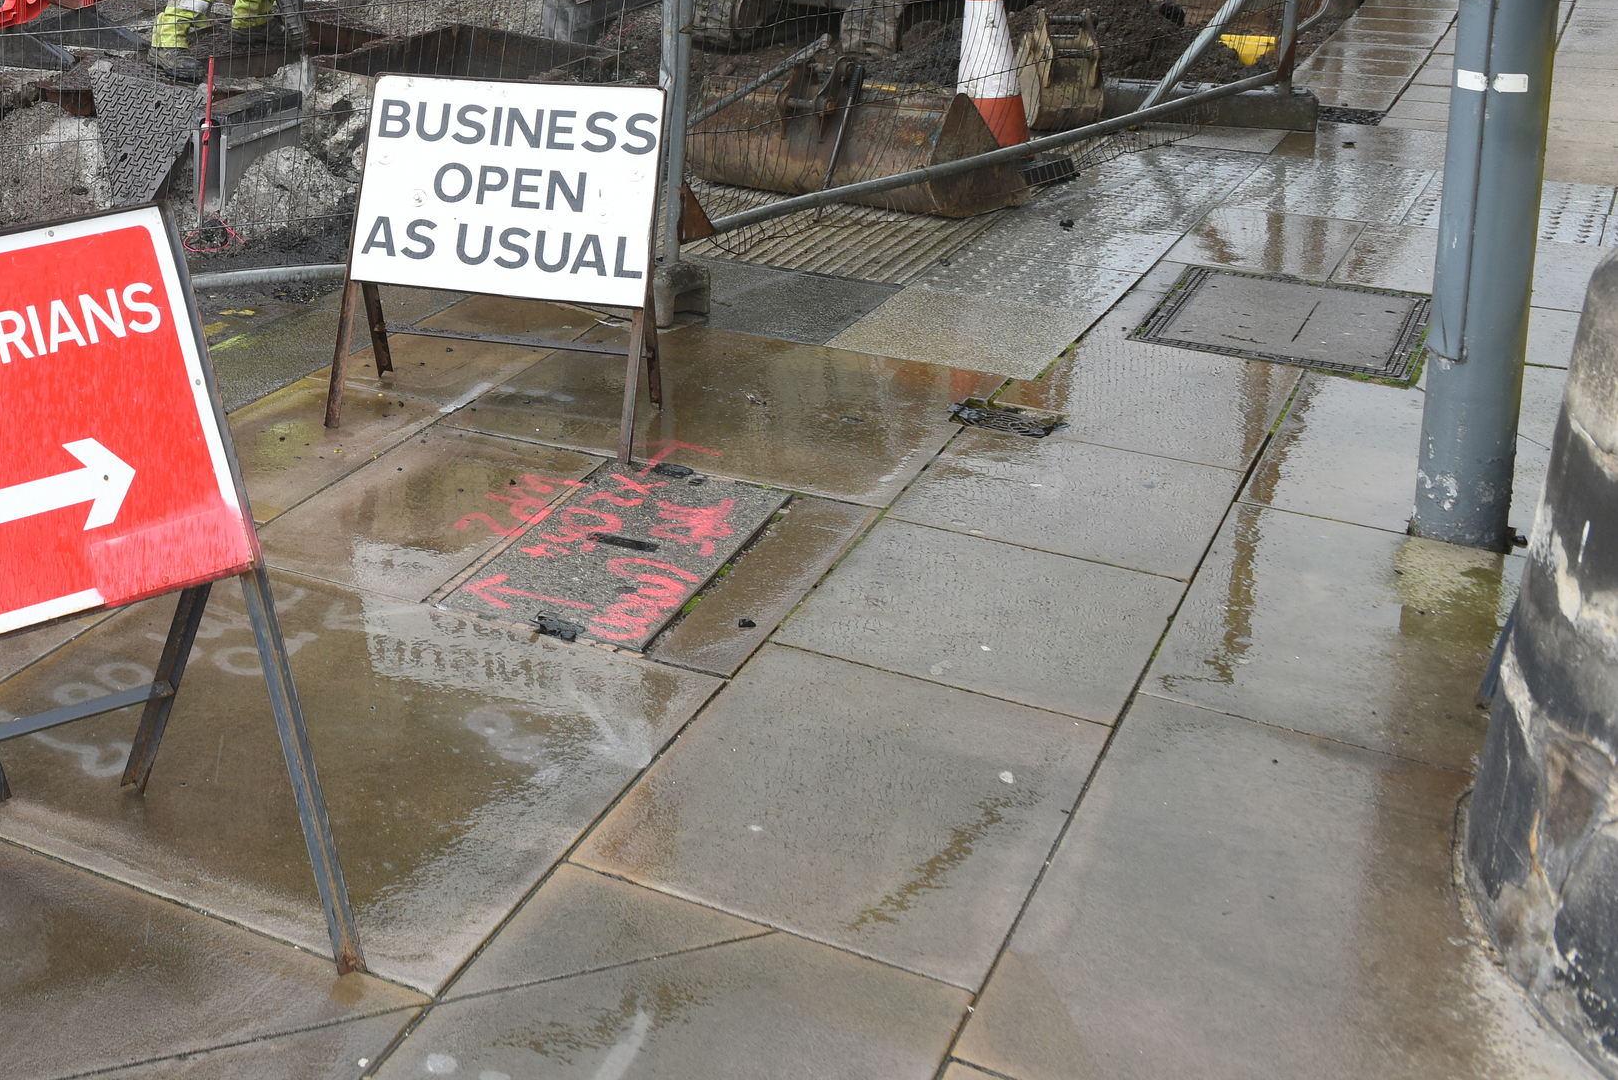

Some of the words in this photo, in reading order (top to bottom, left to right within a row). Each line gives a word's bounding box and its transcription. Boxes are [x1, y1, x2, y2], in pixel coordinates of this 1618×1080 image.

[378, 99, 659, 156] BUSINESS
[433, 162, 587, 213] OPEN
[361, 216, 438, 260] AS
[456, 223, 643, 279] USUAL
